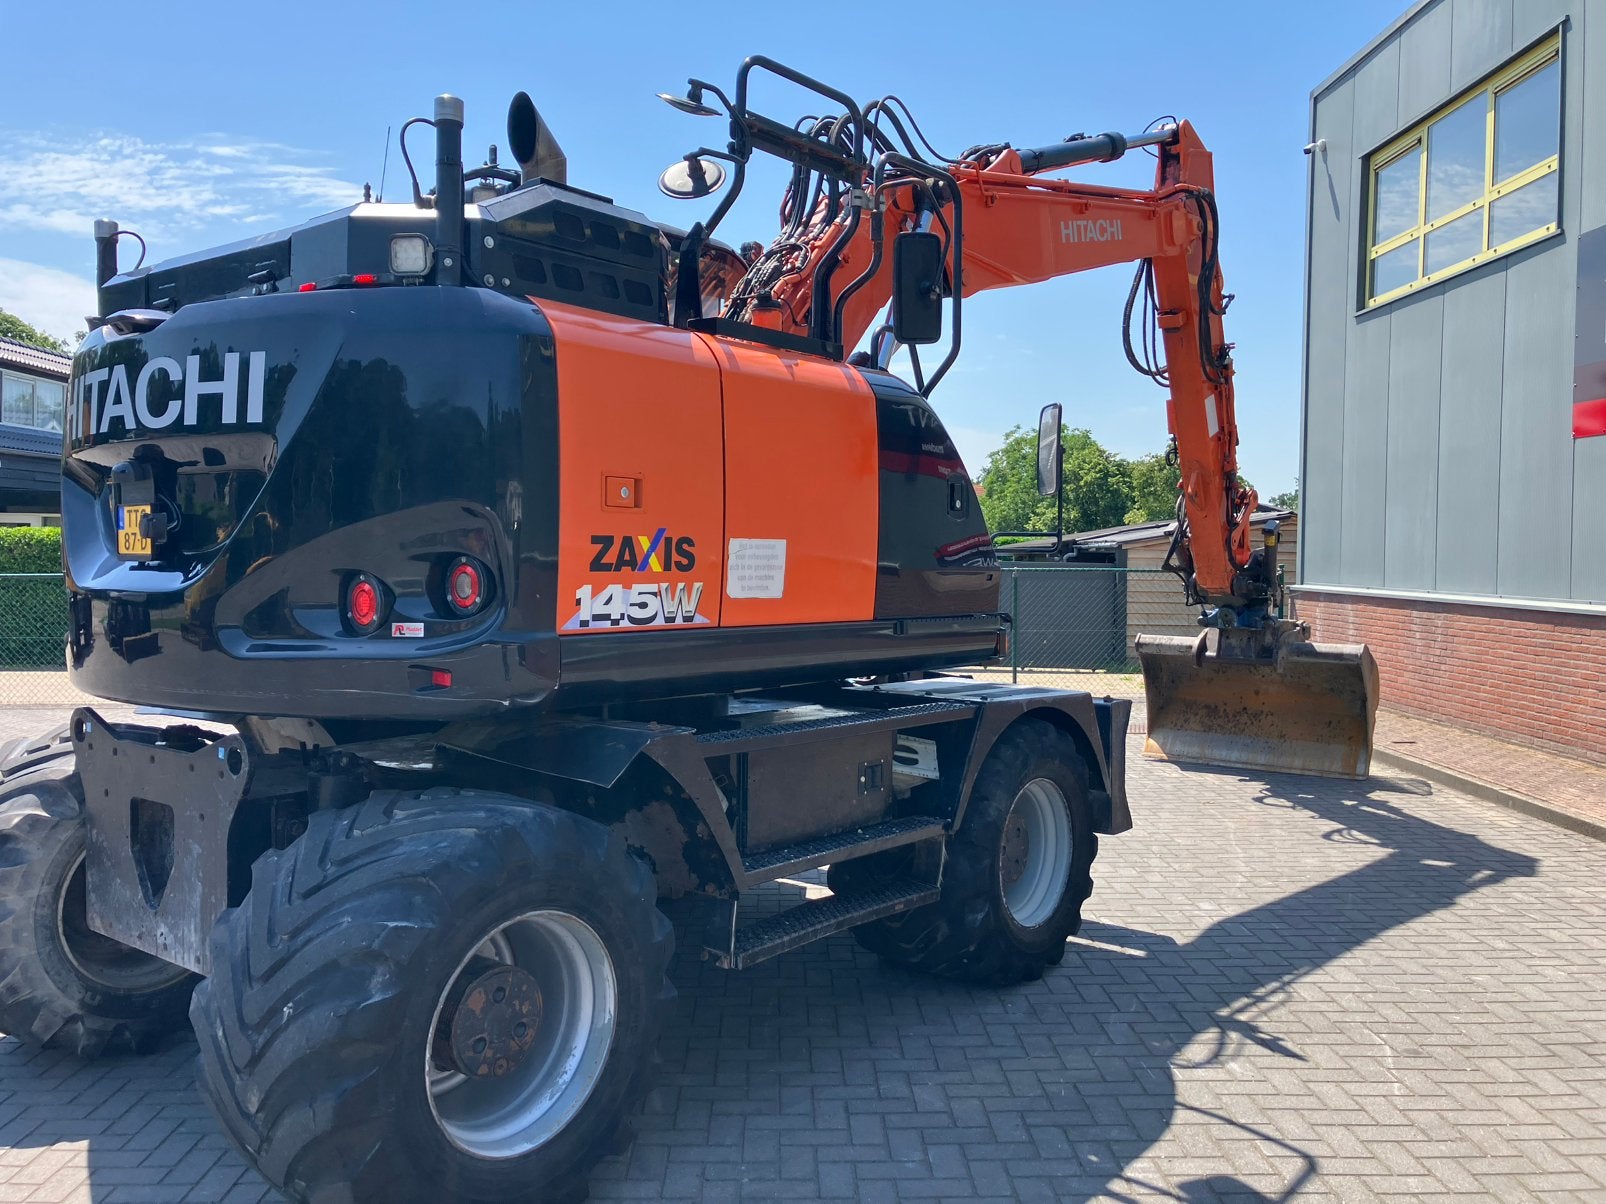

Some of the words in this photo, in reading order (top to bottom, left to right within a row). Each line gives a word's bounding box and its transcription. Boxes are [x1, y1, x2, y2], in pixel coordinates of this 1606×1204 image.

[1060, 219, 1122, 243] HITACHI
[67, 351, 266, 440] HITACHI
[127, 509, 147, 528] TT
[589, 528, 696, 572] ZAXIS
[575, 582, 704, 627] 145W
